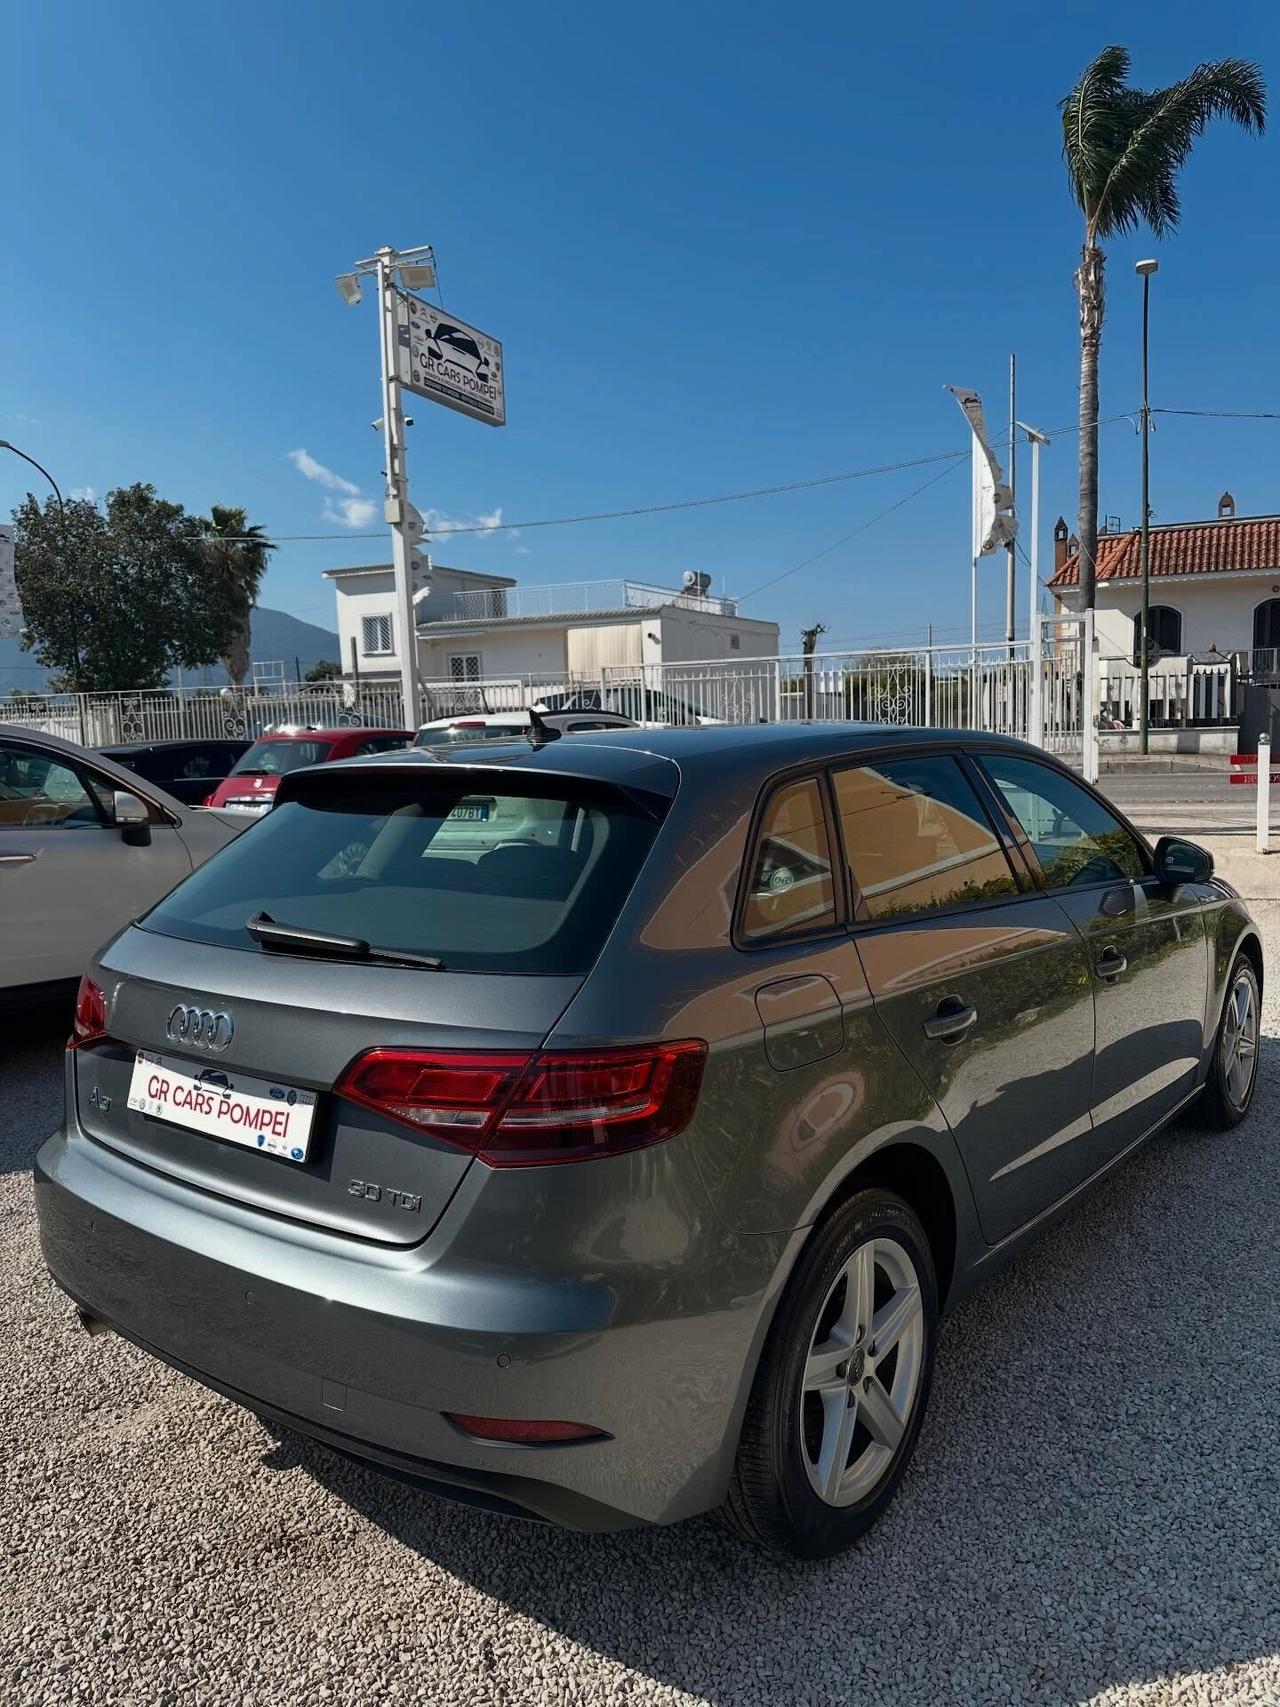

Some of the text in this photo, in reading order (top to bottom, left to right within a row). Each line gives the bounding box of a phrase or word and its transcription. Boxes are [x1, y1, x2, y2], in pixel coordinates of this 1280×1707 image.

[420, 353, 435, 372] GR
[437, 362, 461, 384] CARS
[463, 375, 497, 401] POMPEI
[148, 1075, 290, 1138] GR CARS POMPEI
[386, 1188, 423, 1214] TDI
